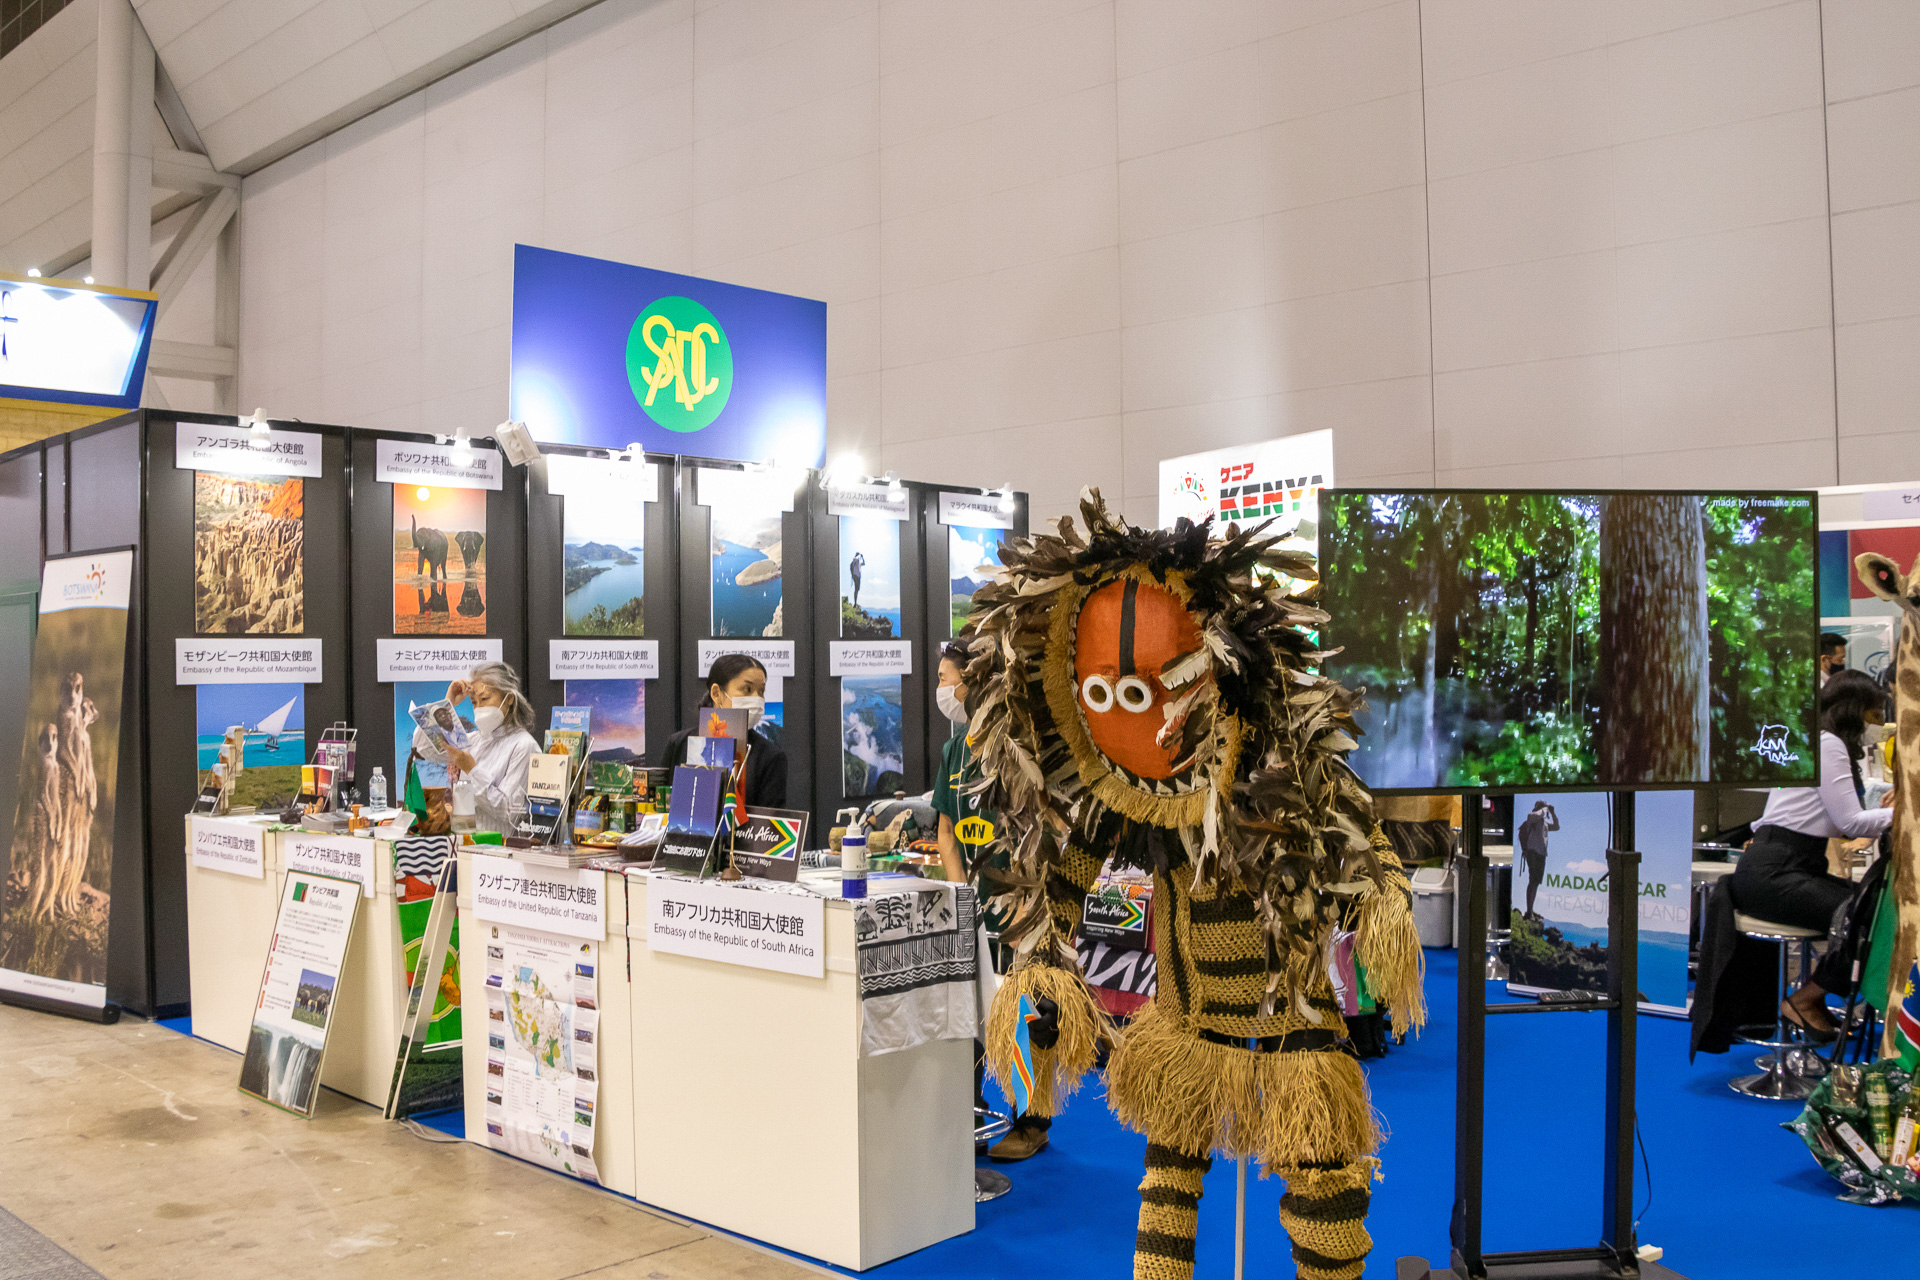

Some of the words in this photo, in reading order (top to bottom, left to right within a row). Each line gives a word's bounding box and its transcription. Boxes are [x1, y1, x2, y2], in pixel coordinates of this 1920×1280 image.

[285, 458, 307, 466] Angola
[394, 452, 487, 470] ボツワナ共和使館
[387, 465, 412, 474] Embassy
[466, 472, 493, 480] Botswana
[1221, 462, 1254, 483] ケニア
[1220, 474, 1324, 522] KENYA
[1713, 499, 1735, 507] made
[1739, 499, 1749, 508] by
[950, 501, 1000, 513] マラウイ共和国大使
[184, 650, 312, 662] モザンビーク共和国大使館
[395, 650, 487, 661] ナミビア共和国大使館
[562, 650, 648, 661] 南アフリカ共和国大使館
[842, 650, 901, 659] ザンビア共和国大使館
[183, 666, 212, 674] Embassy
[236, 666, 264, 674] Republic
[436, 664, 459, 672] Republic
[736, 826, 754, 840] outh
[755, 826, 779, 842] Africa
[296, 843, 361, 867] ザンビア共和国大使館
[479, 874, 596, 905] タンザニア連合共和国大使館
[1546, 874, 1666, 898] MADAGAR
[478, 894, 500, 907] Embassy
[501, 898, 507, 906] of
[508, 898, 517, 909] the
[519, 900, 536, 912] United
[538, 904, 561, 916] Republic
[564, 907, 570, 917] of
[571, 909, 597, 922] Tanzania
[1088, 902, 1108, 914] South
[1109, 904, 1129, 917] Africa
[1547, 894, 1608, 914] TREASU
[1638, 903, 1689, 922] LAND
[662, 899, 804, 936] 南アフリカ共和国大使館
[654, 923, 686, 940] Embassy
[688, 928, 696, 939] of
[699, 930, 711, 941] the
[714, 932, 748, 948] Republic
[751, 936, 759, 949] of
[761, 939, 786, 953] South
[788, 944, 814, 957] Africa
